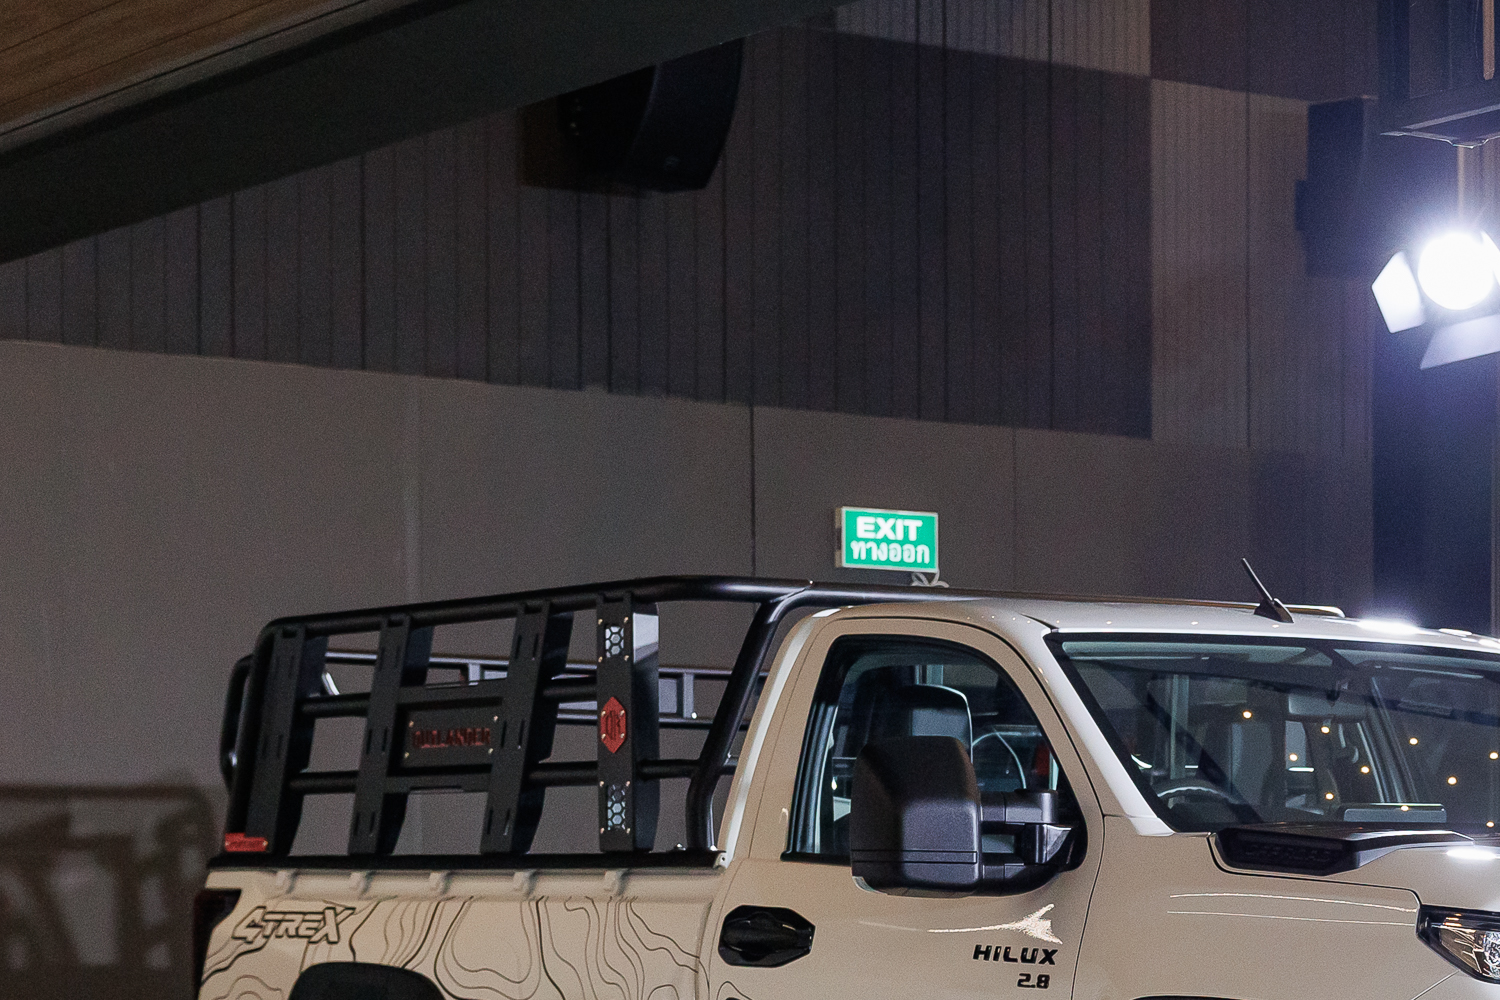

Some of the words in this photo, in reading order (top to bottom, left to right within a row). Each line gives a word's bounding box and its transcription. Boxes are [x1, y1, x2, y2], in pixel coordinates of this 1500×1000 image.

[856, 516, 923, 541] EXIT
[850, 540, 930, 564] ทางออก
[972, 944, 1059, 966] HILUX
[1016, 973, 1050, 990] 2.8
